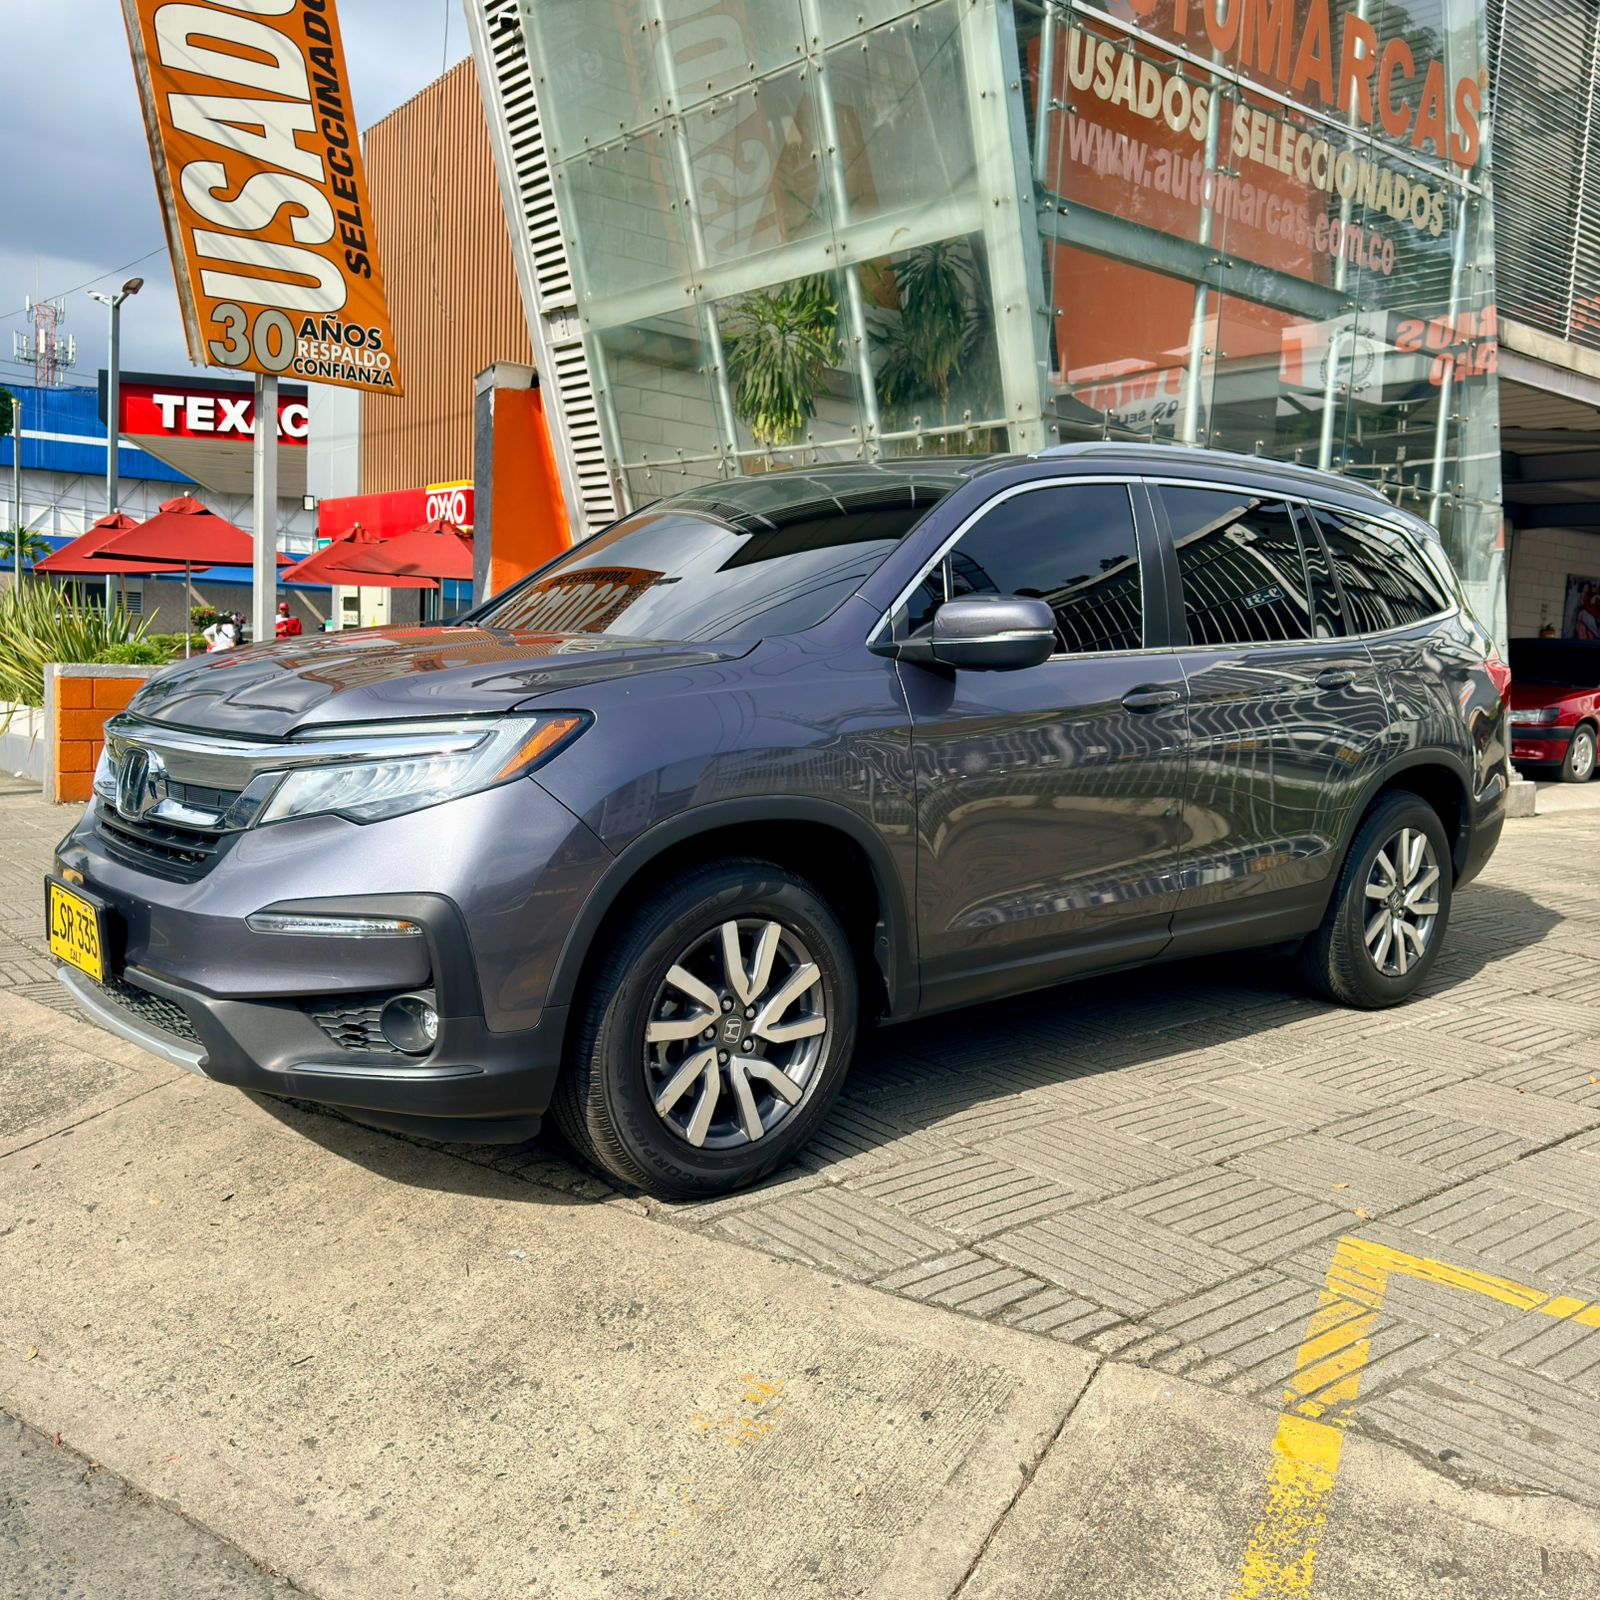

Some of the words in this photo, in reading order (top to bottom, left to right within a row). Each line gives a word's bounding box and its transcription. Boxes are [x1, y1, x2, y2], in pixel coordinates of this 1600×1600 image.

[154, 0, 347, 313] USAD
[1068, 28, 1211, 141] USADOS
[1232, 105, 1444, 237] SELECCIONADOS
[208, 302, 297, 372] 30
[298, 315, 382, 350] AÑOS
[297, 341, 391, 370] RESPALDO
[293, 357, 394, 387] CONFIANZA
[426, 489, 467, 524] OXXO
[51, 897, 75, 946] LSR
[75, 910, 98, 959] 335
